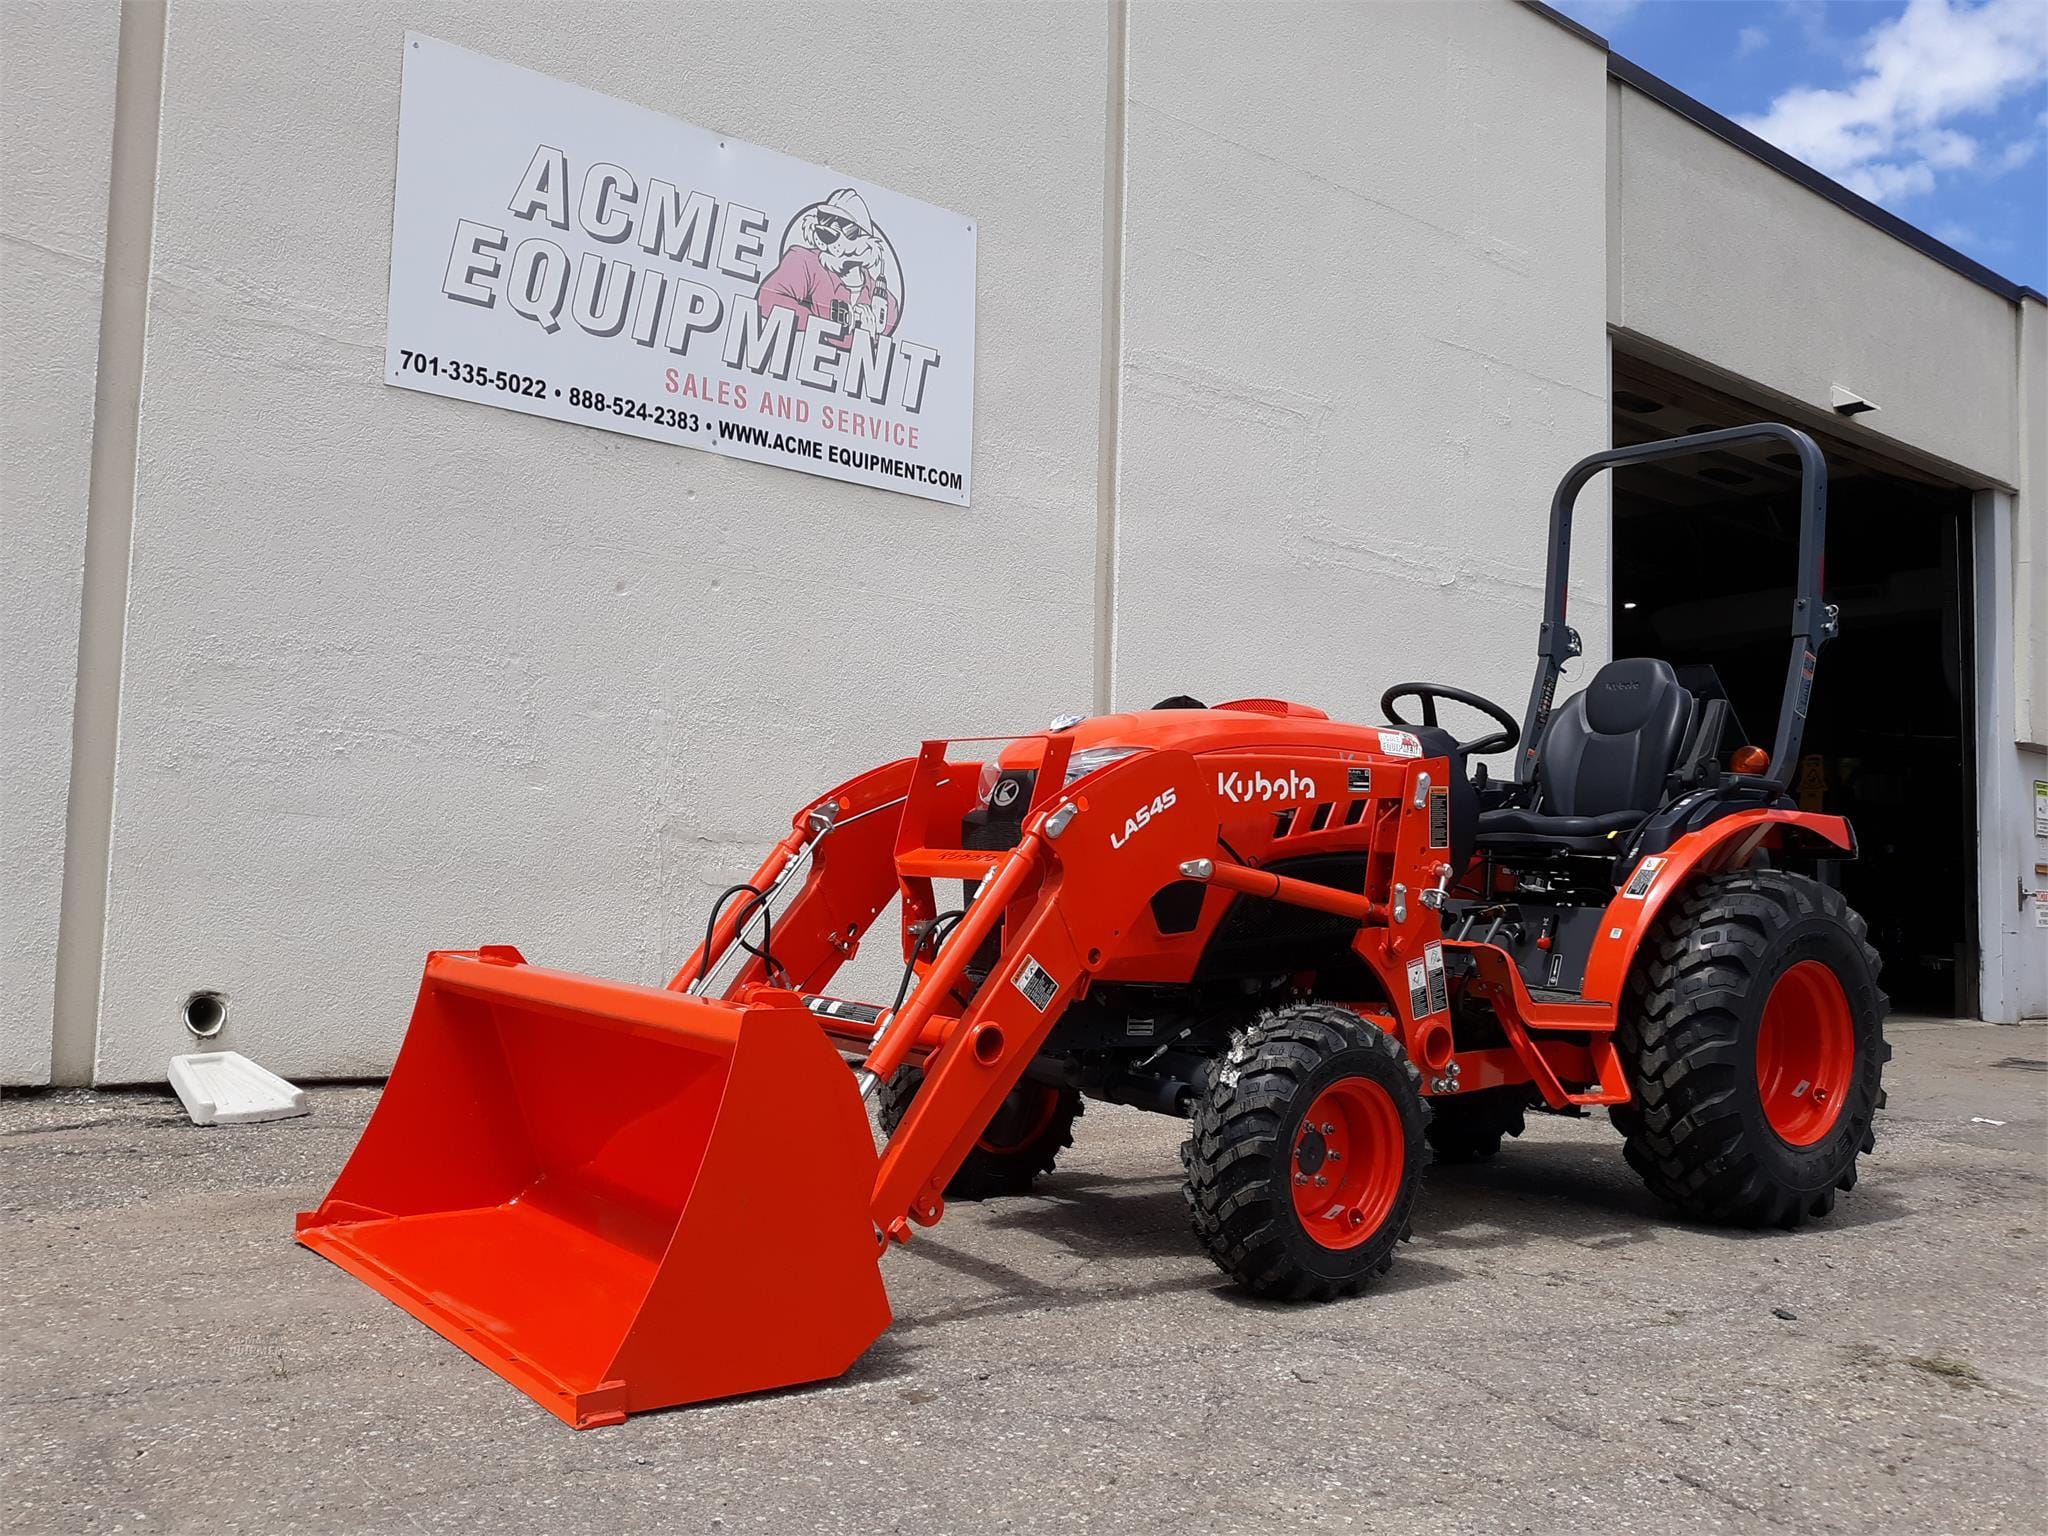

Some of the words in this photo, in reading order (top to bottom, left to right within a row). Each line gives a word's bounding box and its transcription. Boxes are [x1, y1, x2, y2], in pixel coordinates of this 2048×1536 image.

[507, 143, 770, 285] ACME
[441, 217, 941, 415] EQUIPMENT
[400, 349, 547, 399] 701-335-5022
[569, 387, 700, 432] 888-524-2383
[828, 446, 963, 490] EQUIPMENT.COM
[664, 367, 748, 409] SALES
[759, 391, 810, 423] AND
[821, 405, 920, 449] SERVICE
[1109, 787, 1177, 850] LA545
[1217, 769, 1316, 803] Kubota
